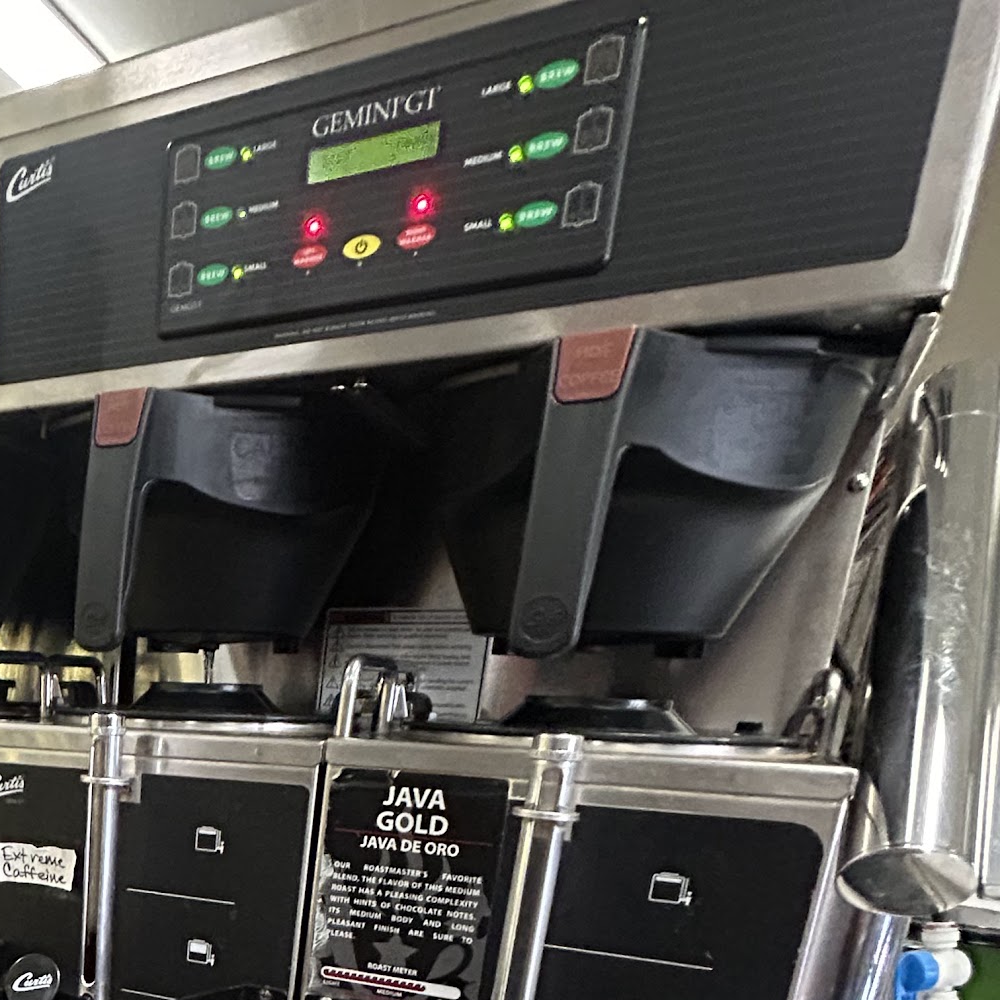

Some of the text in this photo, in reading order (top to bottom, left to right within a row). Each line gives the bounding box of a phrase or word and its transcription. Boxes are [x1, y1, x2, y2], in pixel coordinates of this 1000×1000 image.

[540, 63, 577, 83] BREW
[530, 137, 565, 153] BREW
[464, 151, 502, 168] MEDIUM
[6, 158, 53, 203] Curtis
[204, 210, 231, 224] BREW
[464, 218, 492, 232] SMALL
[200, 268, 226, 281] BREW
[383, 785, 446, 811] JAVA
[376, 811, 449, 836] GOLD
[1, 846, 65, 869] Extreme
[360, 835, 460, 857] JAVA DE ORO
[3, 861, 67, 884] Caffeine
[333, 860, 483, 885] OUR ROASTMASTER'S FAVORITE
[333, 872, 481, 896] BLEND, THE FLAVOR OF THIS MEDIUM
[331, 883, 479, 909] ROAST HAS A PLEASING COMPLEXITY
[328, 906, 475, 933] ITS MEDIUM BODY AND LONG
[330, 895, 477, 921] WITH HINTS OF CHOCOLATE NOTES.
[327, 918, 474, 945] PLEASANT FINISH ARE SURE TO
[367, 962, 418, 977] ROAST METER
[12, 972, 53, 992] Curtis
[376, 988, 403, 998] MEDIUM
